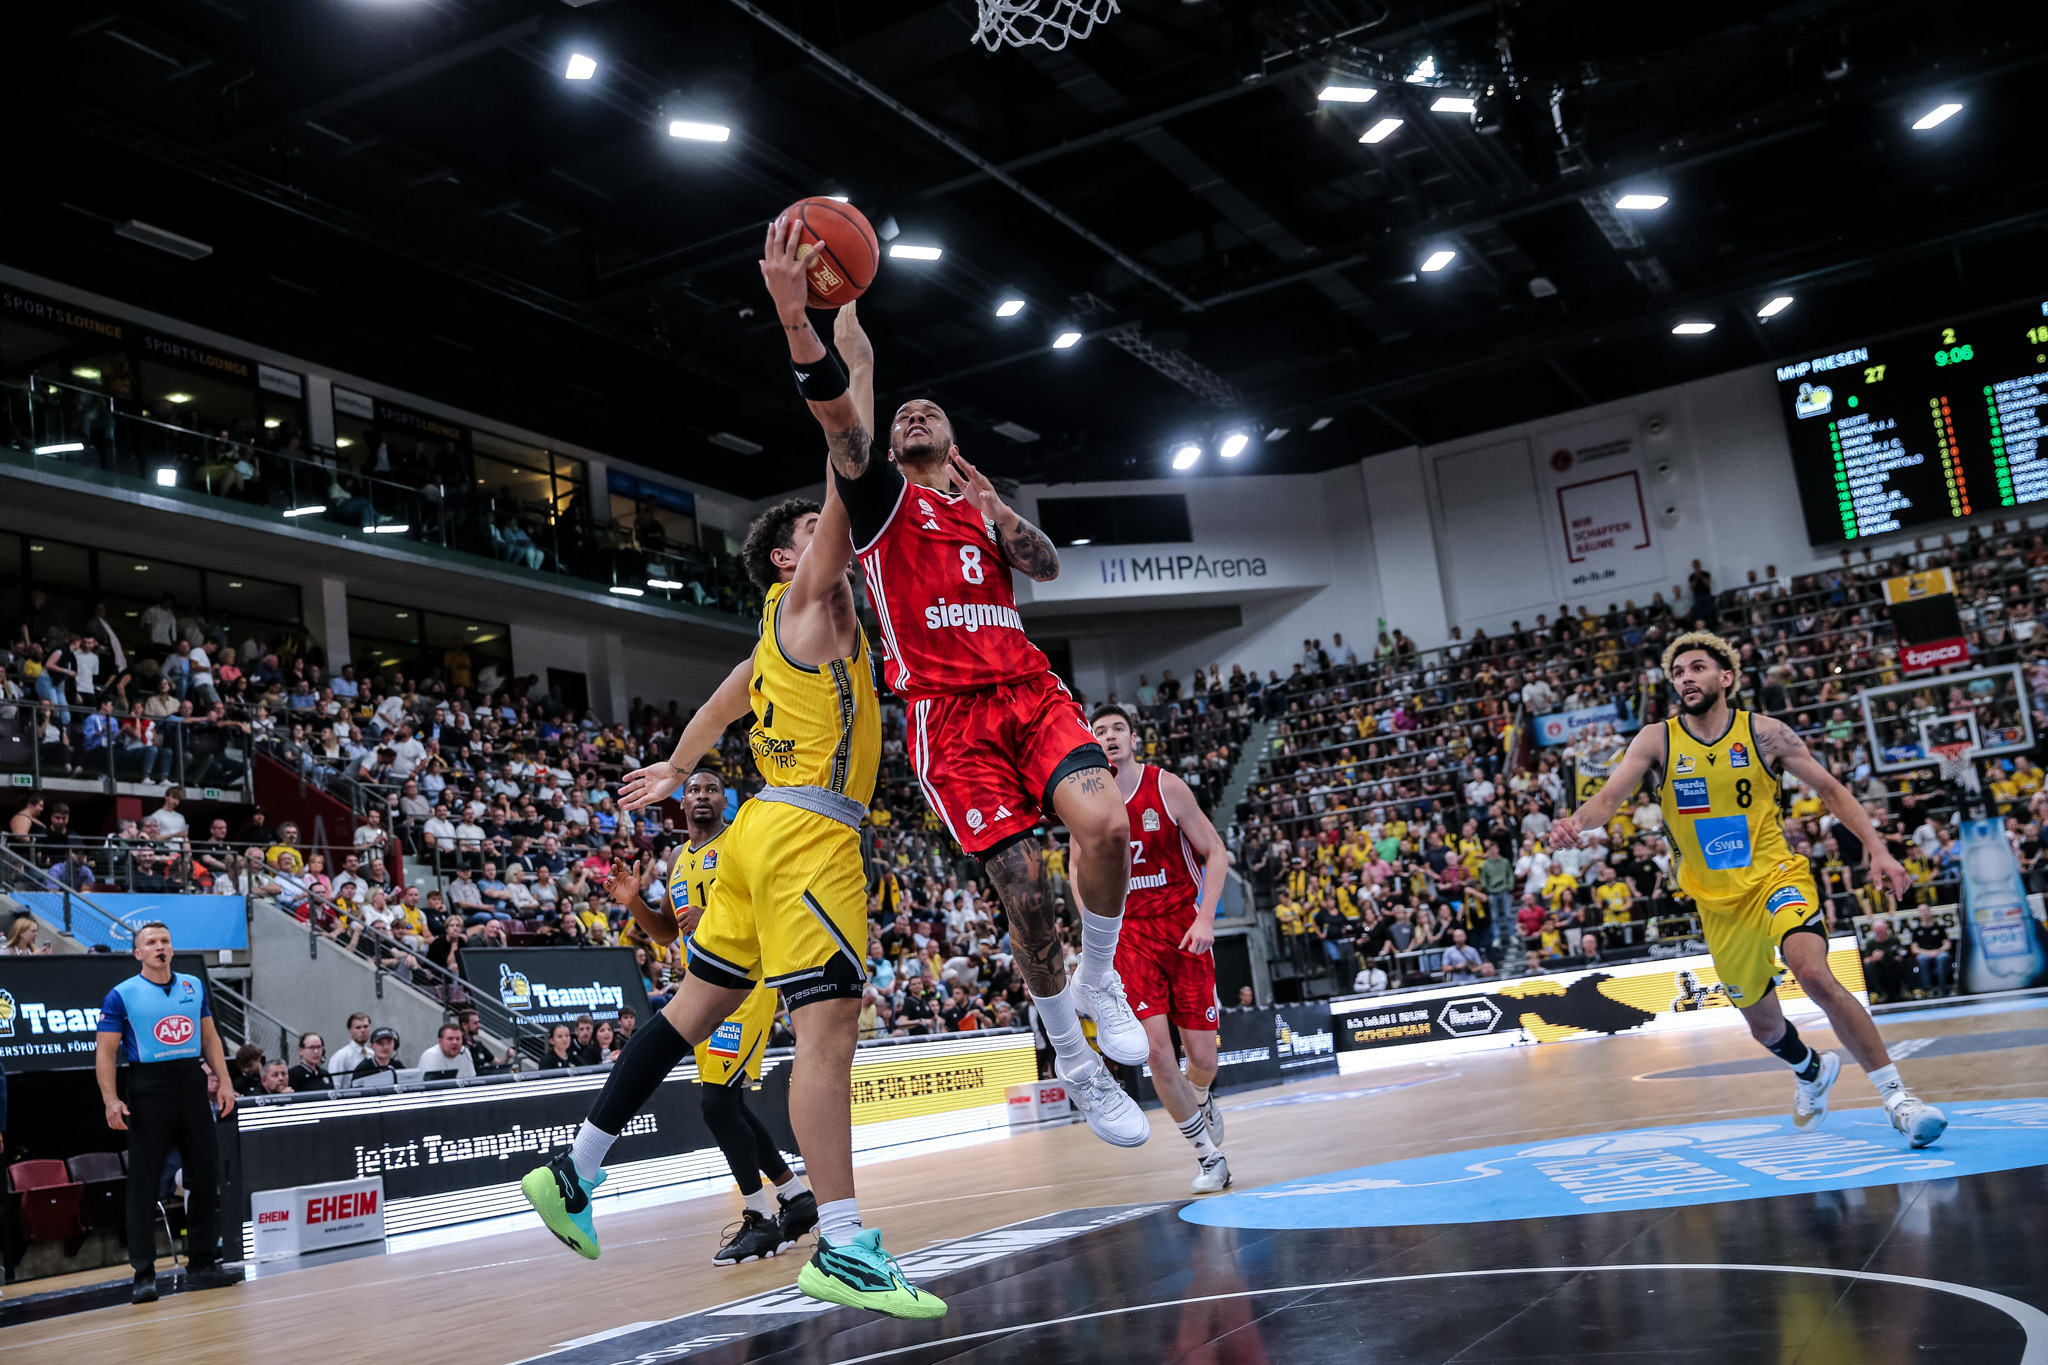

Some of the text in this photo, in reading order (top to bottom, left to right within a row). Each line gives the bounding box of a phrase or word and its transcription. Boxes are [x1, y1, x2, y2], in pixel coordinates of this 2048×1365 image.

[1941, 328, 1956, 345] 2
[1776, 347, 1869, 382] MHP RIESEN
[1934, 344, 1974, 367] 9:06
[1863, 364, 1887, 384] 27
[959, 544, 984, 585] 8
[1131, 554, 1267, 582] MHPArena
[1905, 645, 1961, 666] tipico
[1674, 780, 1705, 791] Sparda
[1683, 788, 1706, 796] Bank
[1735, 778, 1752, 809] 8
[1714, 840, 1744, 851] SWLB
[531, 981, 624, 1010] Teamplay
[717, 1030, 740, 1040] Bank
[0, 1043, 66, 1057] ERSTÜTZEN.
[354, 1139, 419, 1178] Jetzt
[258, 1210, 290, 1224] EHEIM
[306, 1190, 378, 1225] EHEIM
